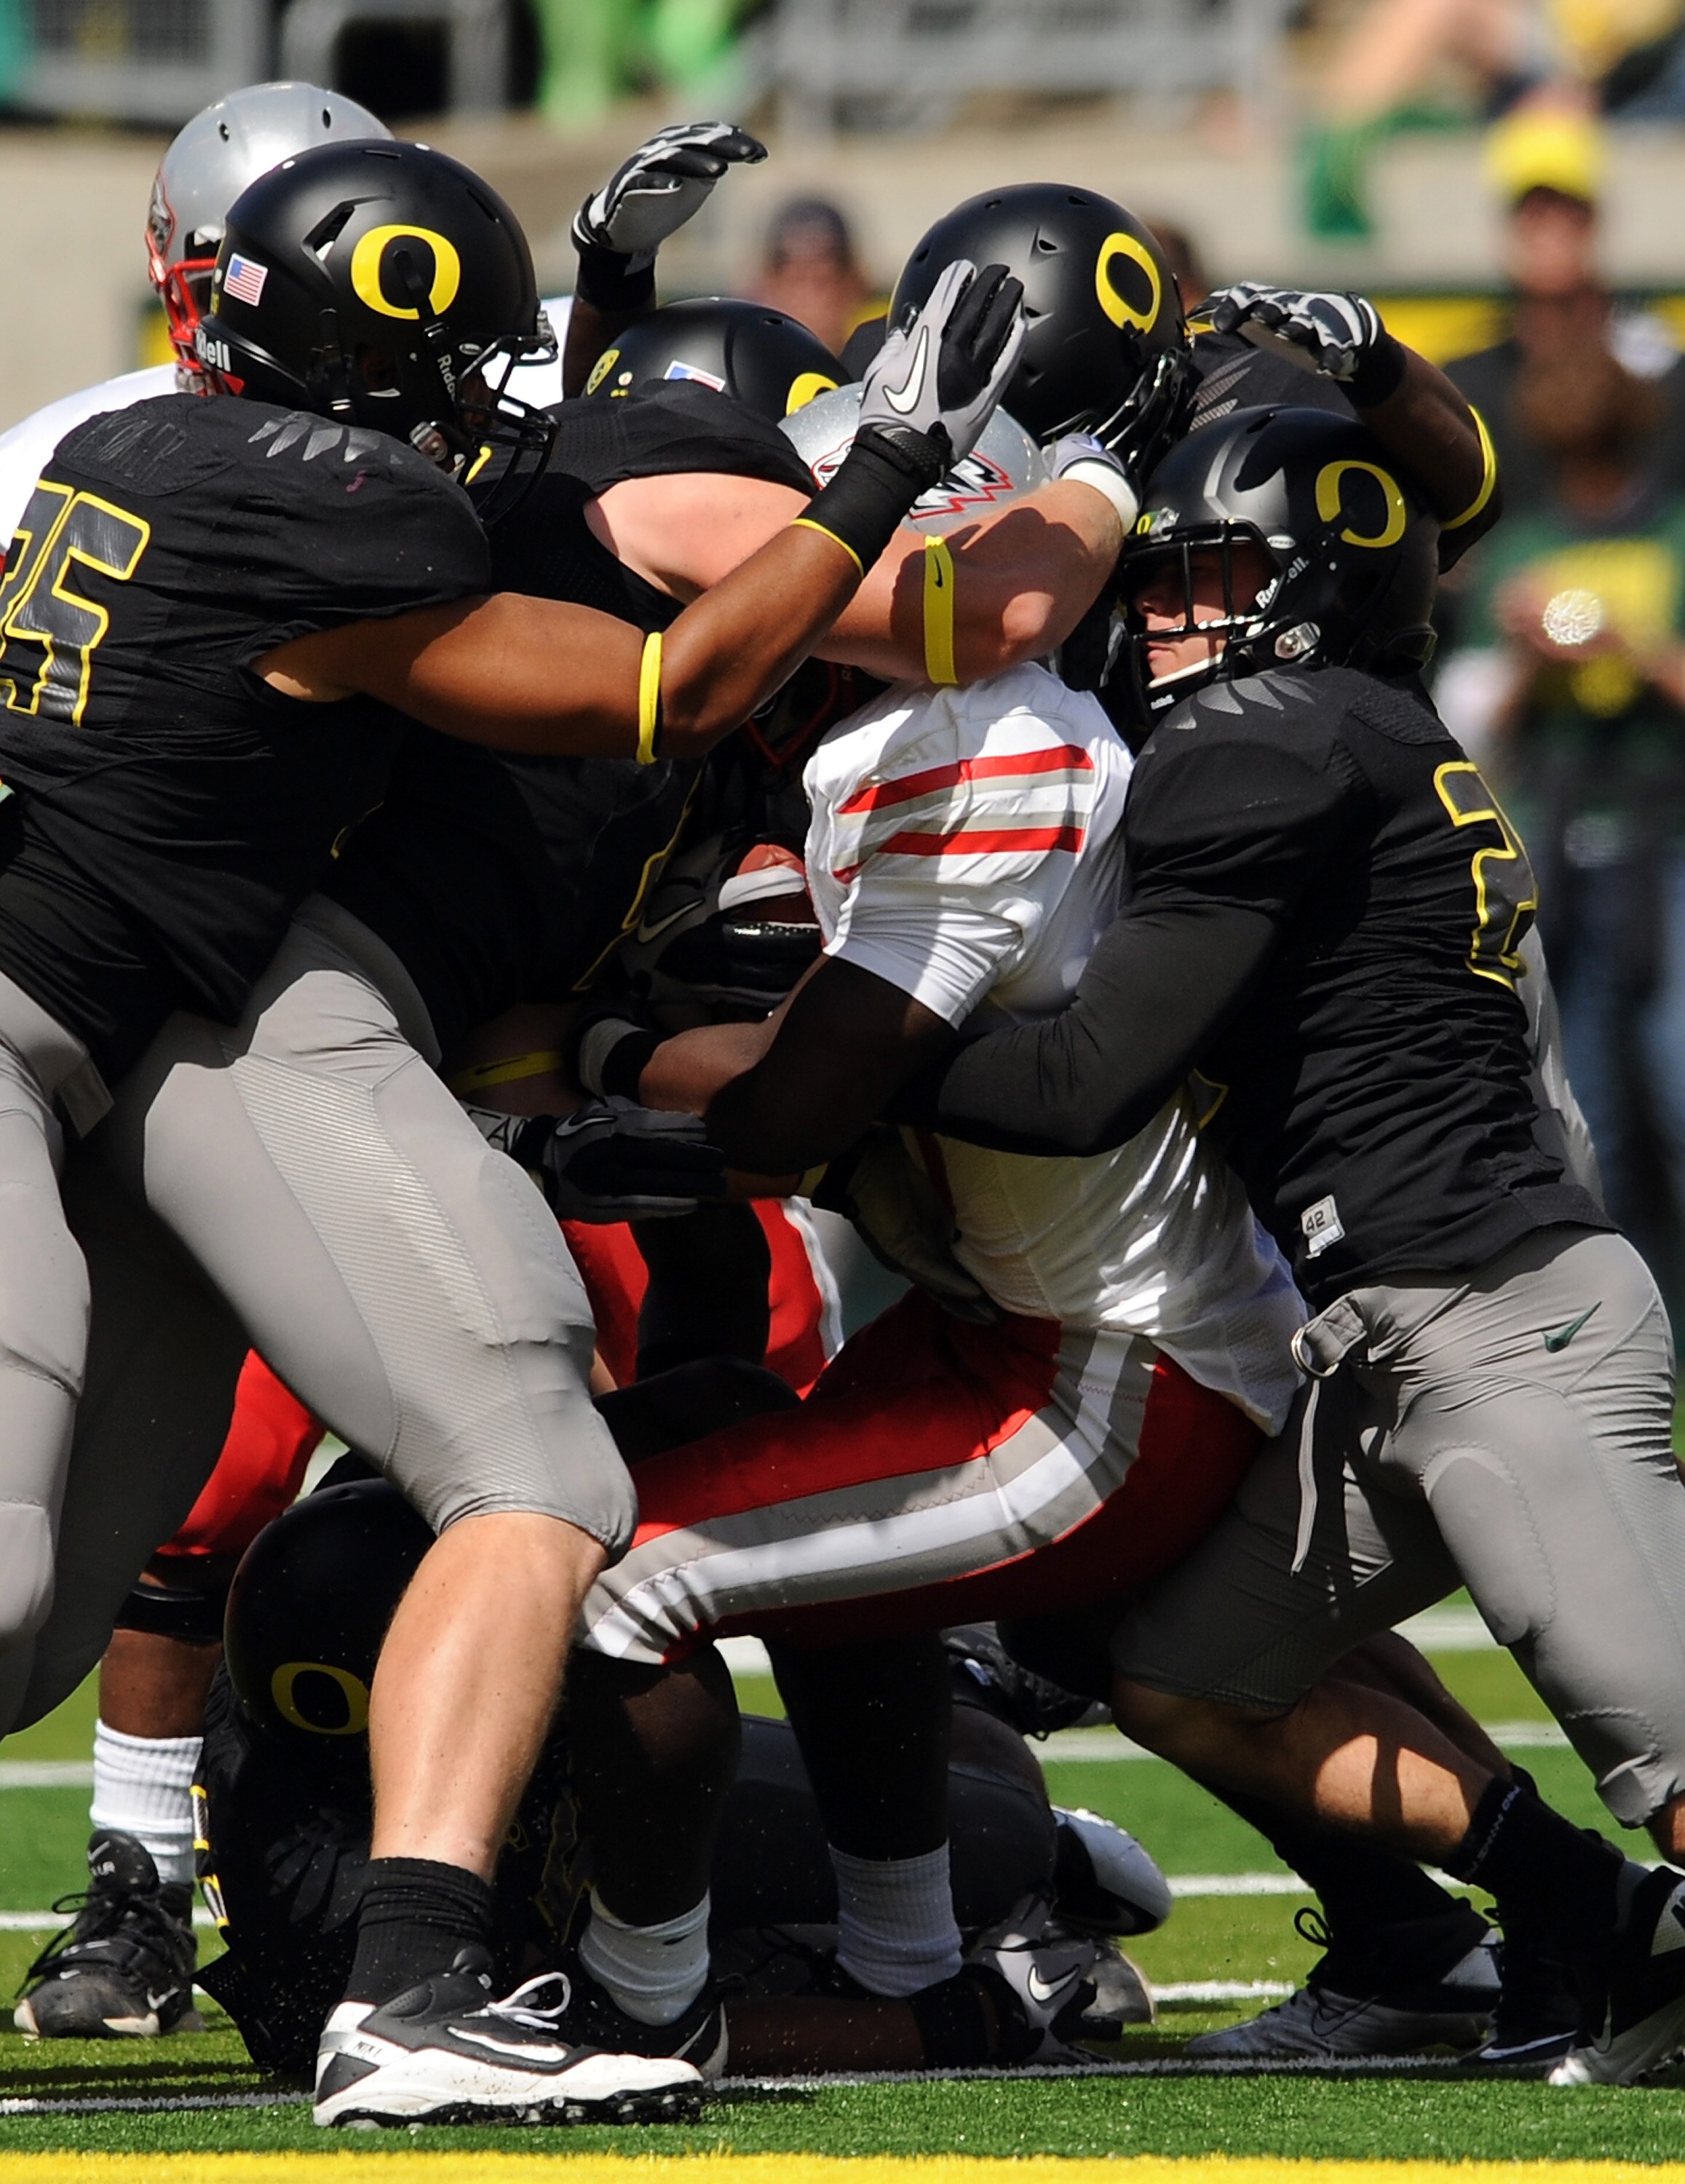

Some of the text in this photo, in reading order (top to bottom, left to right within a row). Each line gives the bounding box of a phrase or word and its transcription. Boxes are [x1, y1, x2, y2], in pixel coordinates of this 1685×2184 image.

[351, 224, 461, 320] O
[1095, 232, 1161, 336] O
[1306, 1209, 1325, 1232] 42
[271, 1661, 370, 1735] O
